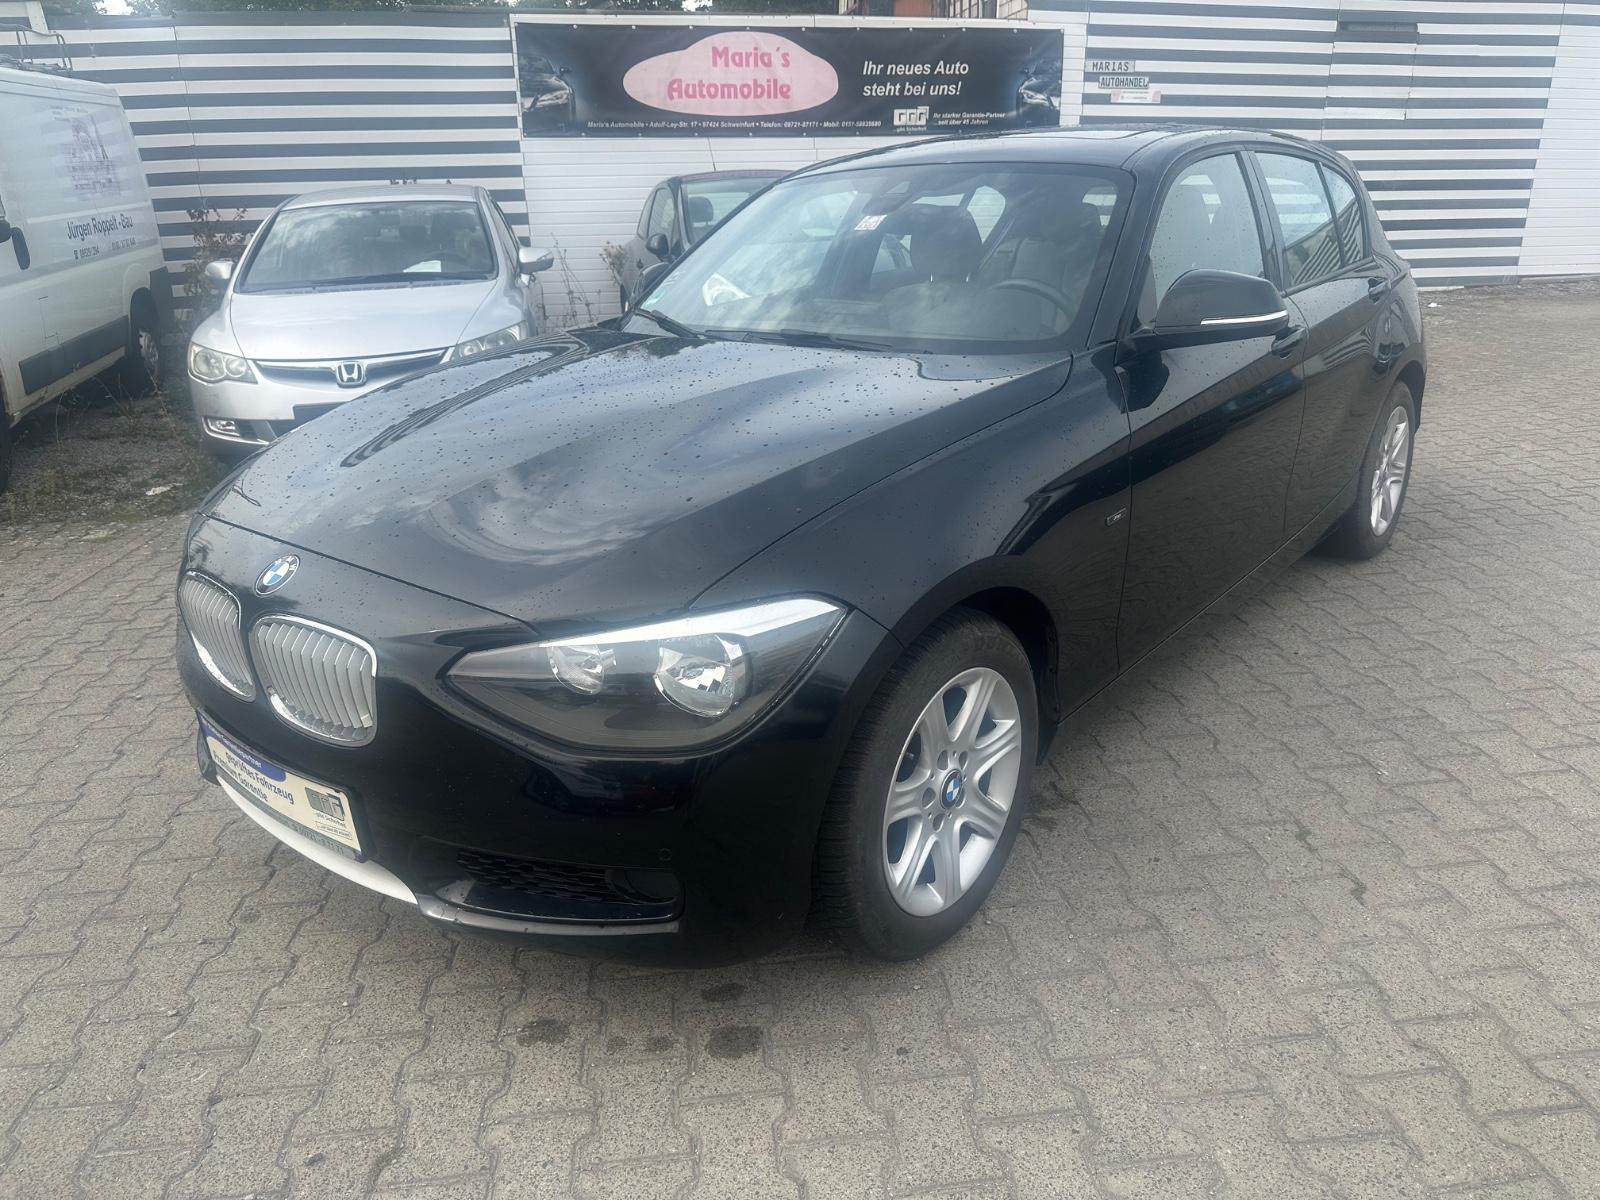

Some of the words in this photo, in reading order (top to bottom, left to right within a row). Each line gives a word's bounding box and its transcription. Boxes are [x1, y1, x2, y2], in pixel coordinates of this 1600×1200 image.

[863, 60, 884, 75] Ihr
[886, 63, 931, 75] neues
[933, 60, 969, 75] Auto
[1092, 61, 1130, 72] MARIAS
[666, 78, 792, 101] Automobile
[863, 81, 901, 96] steht
[903, 81, 927, 96] bei
[929, 81, 962, 96] uns!
[1100, 76, 1149, 88] AUTOHANDEL
[67, 220, 93, 242] Jürgen
[91, 215, 118, 237] Roppelt
[254, 772, 295, 805] Fahrzeug
